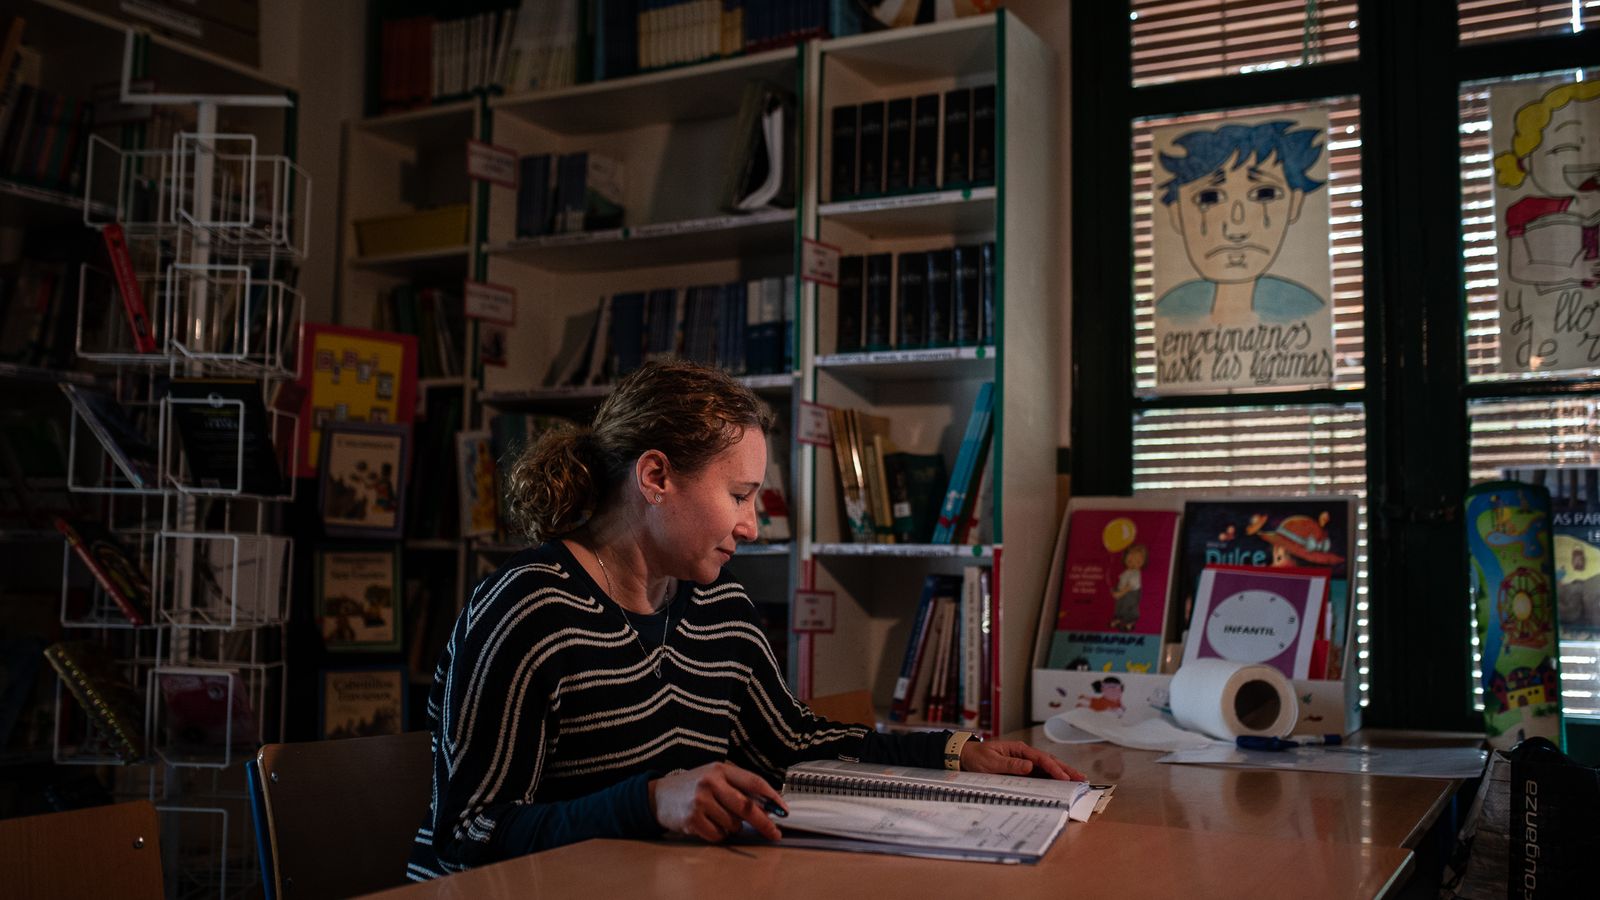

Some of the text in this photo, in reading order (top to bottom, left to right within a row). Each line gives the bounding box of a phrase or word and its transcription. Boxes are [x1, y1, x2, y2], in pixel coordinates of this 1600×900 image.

[1505, 286, 1600, 335] y llo
[1212, 352, 1242, 381] las
[1205, 547, 1268, 567] Dulce
[1223, 624, 1276, 637] INFANTIL
